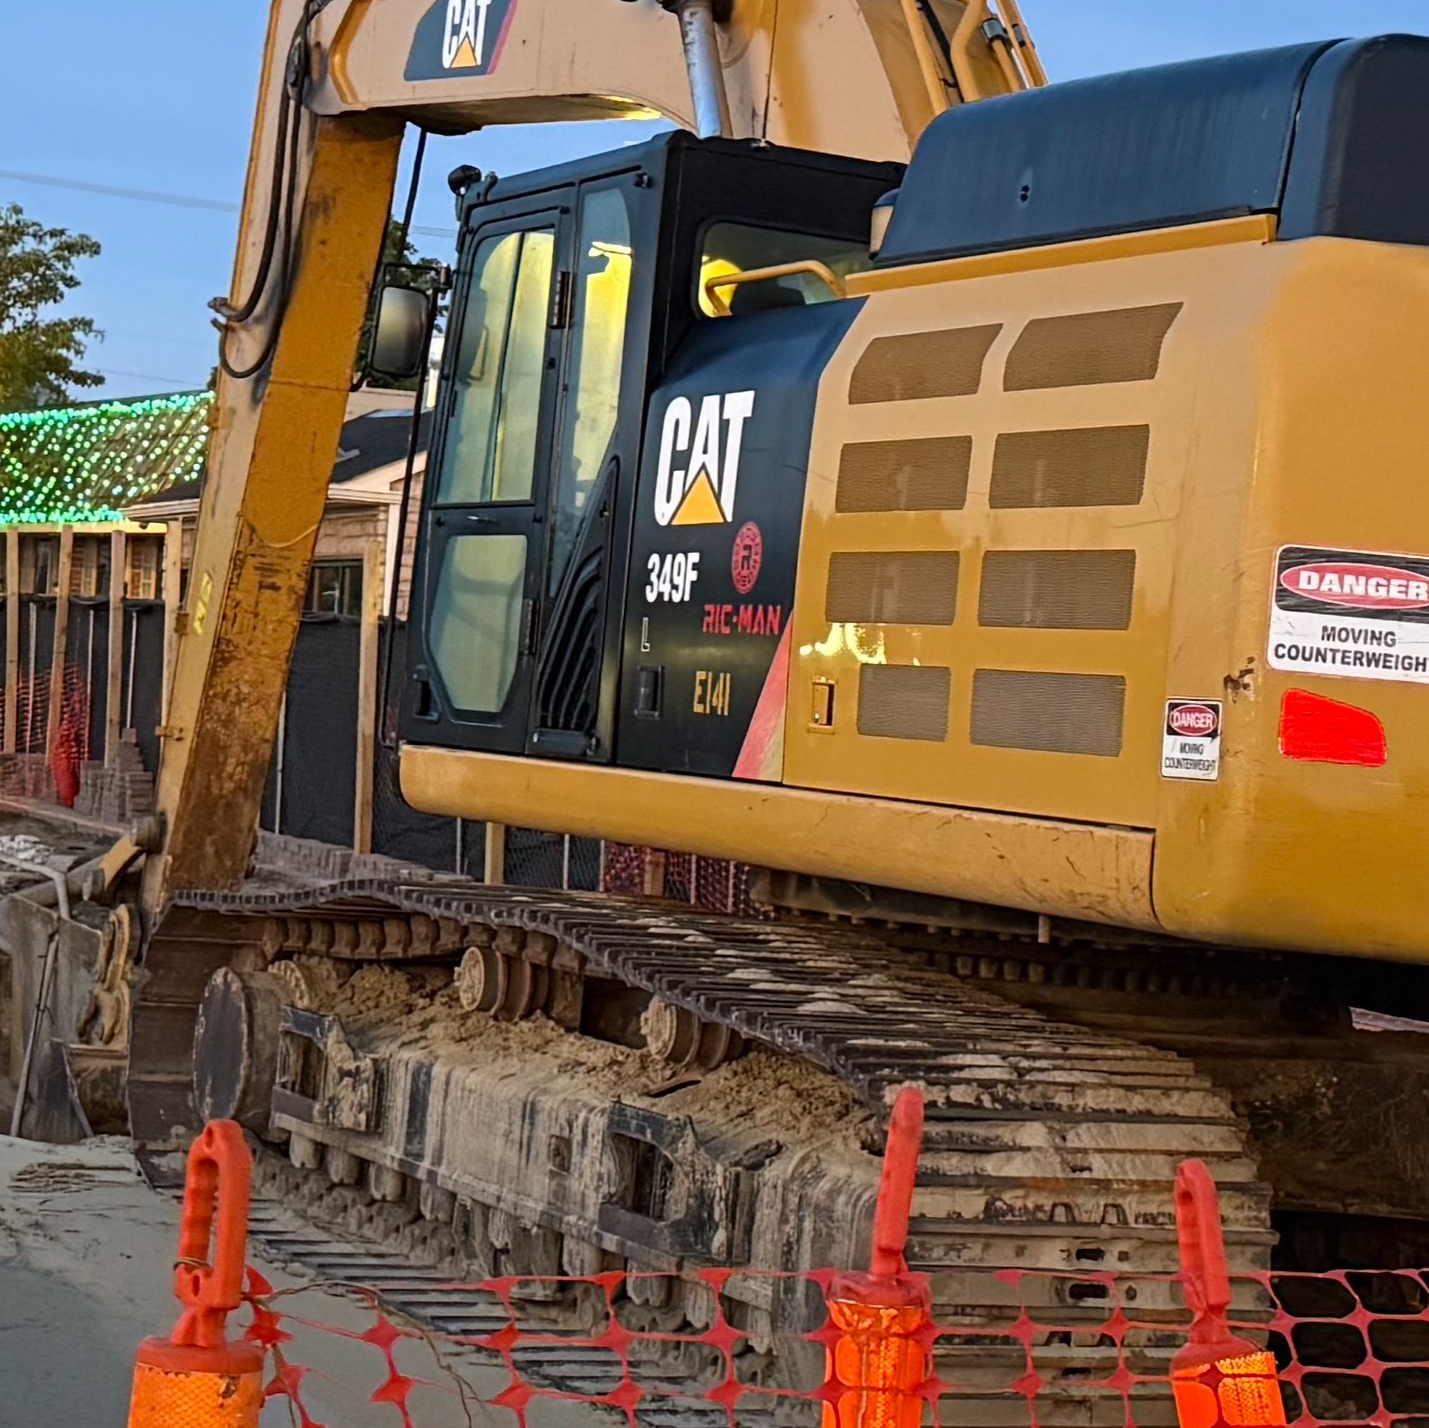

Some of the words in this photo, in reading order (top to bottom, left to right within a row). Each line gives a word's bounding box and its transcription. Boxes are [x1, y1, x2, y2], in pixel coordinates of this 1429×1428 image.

[654, 390, 755, 527] CAT
[645, 552, 700, 603] 349F
[1298, 570, 1429, 601] DANGER
[702, 604, 782, 636] RIC-MAN
[1321, 625, 1397, 648] MOVING
[1173, 712, 1214, 728] DANGER
[1180, 742, 1204, 755] MOVING
[1165, 757, 1217, 771] COUNTERWEIGHT
